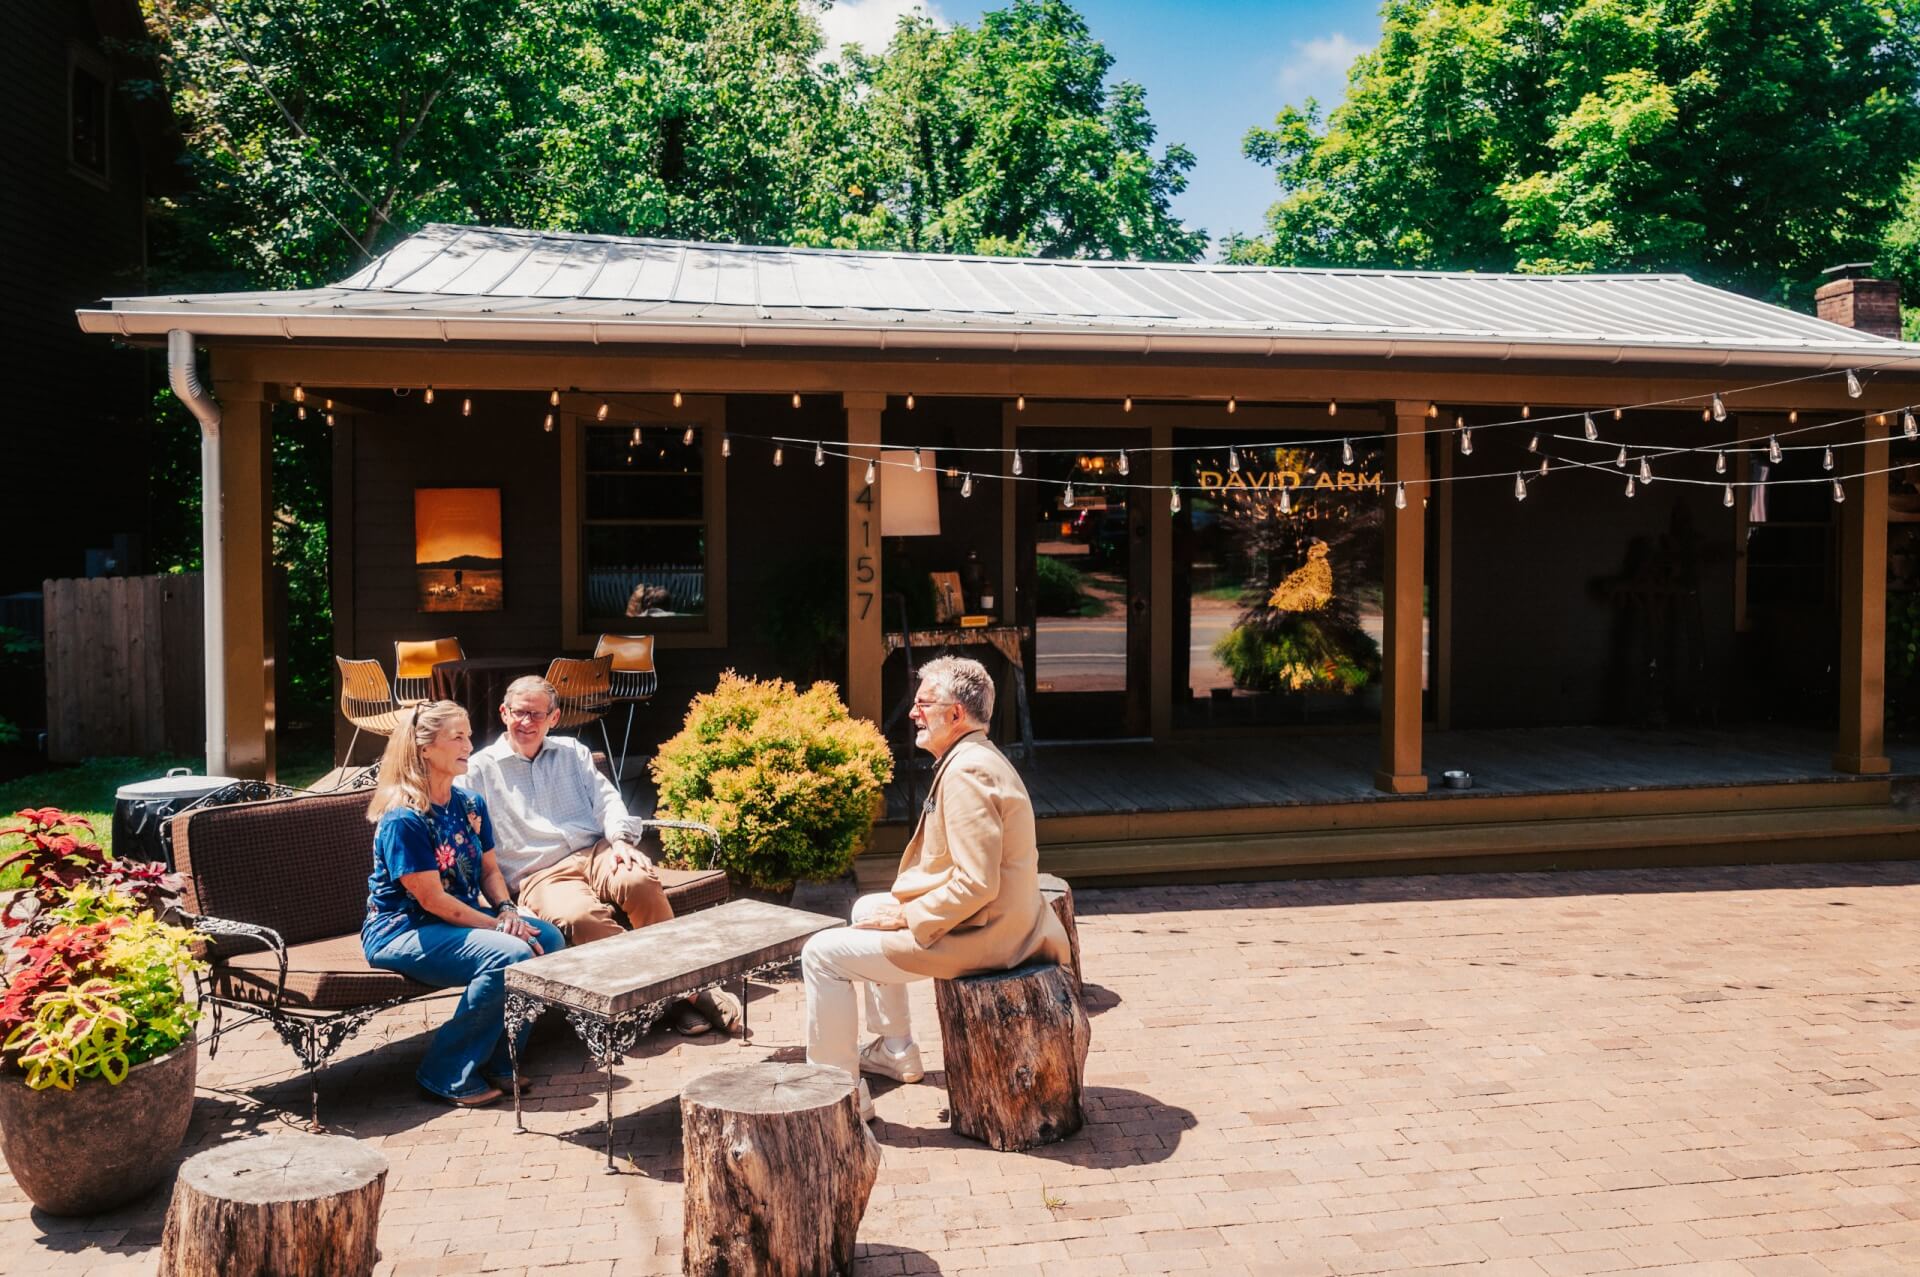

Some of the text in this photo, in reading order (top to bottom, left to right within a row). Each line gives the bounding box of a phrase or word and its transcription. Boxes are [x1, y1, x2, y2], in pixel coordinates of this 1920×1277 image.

[1200, 471, 1381, 493] DAVID ARM
[855, 483, 875, 620] 4157
